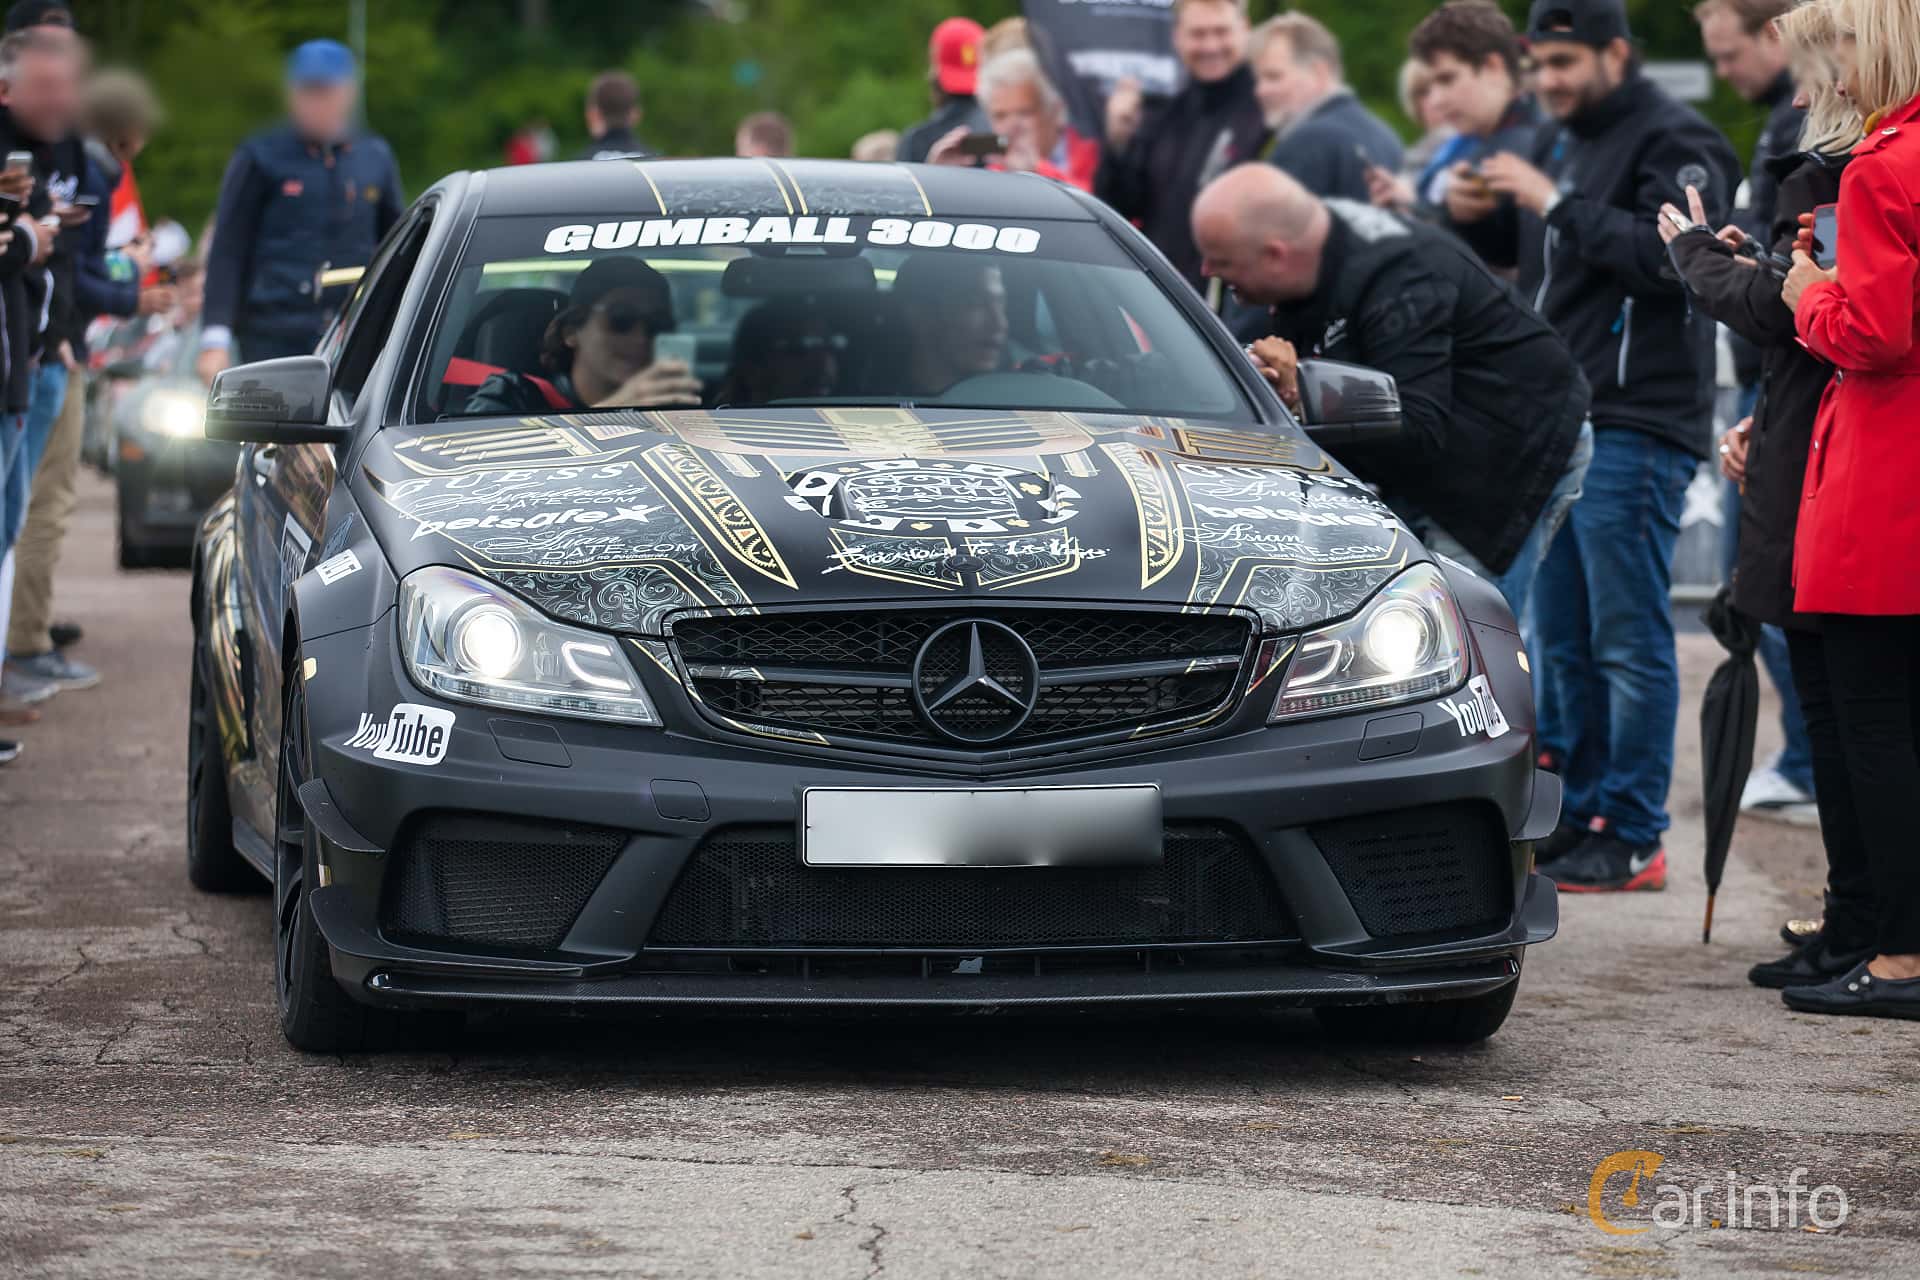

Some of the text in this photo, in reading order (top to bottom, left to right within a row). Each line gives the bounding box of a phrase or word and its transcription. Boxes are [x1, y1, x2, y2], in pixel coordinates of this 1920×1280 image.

[543, 216, 1041, 253] GUMBALL 3000
[391, 463, 629, 501] GUESS
[409, 508, 611, 542] betsafe
[1192, 503, 1385, 527] betsafe
[542, 544, 698, 560] DATE.COM
[1173, 522, 1305, 549] Asian
[1253, 542, 1388, 557] DATE.COM
[1436, 684, 1502, 737] YouT
[343, 711, 446, 760] YouTube
